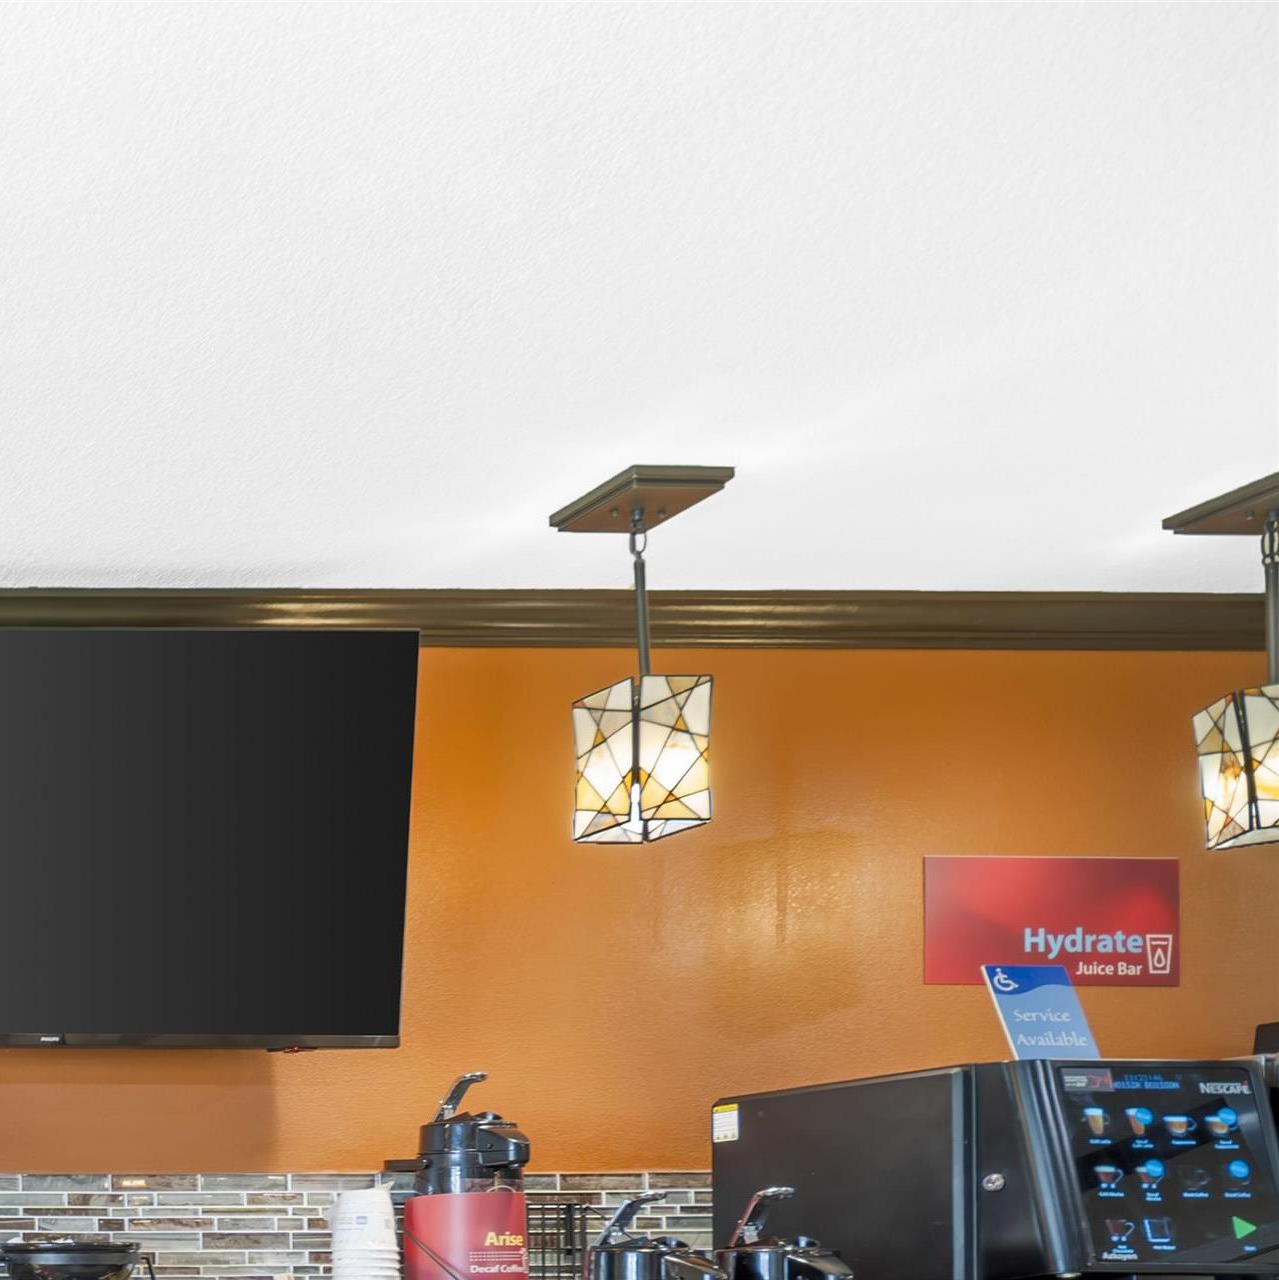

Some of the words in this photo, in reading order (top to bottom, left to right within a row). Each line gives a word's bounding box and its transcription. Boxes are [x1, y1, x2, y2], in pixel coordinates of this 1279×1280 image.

[1024, 927, 1143, 960] Hydrate
[1075, 961, 1114, 976] Juice
[1118, 962, 1142, 975] Bar
[1013, 1008, 1071, 1022] Service
[1017, 1031, 1088, 1047] Available
[484, 1232, 524, 1246] Arise
[470, 1265, 500, 1273] Decaf
